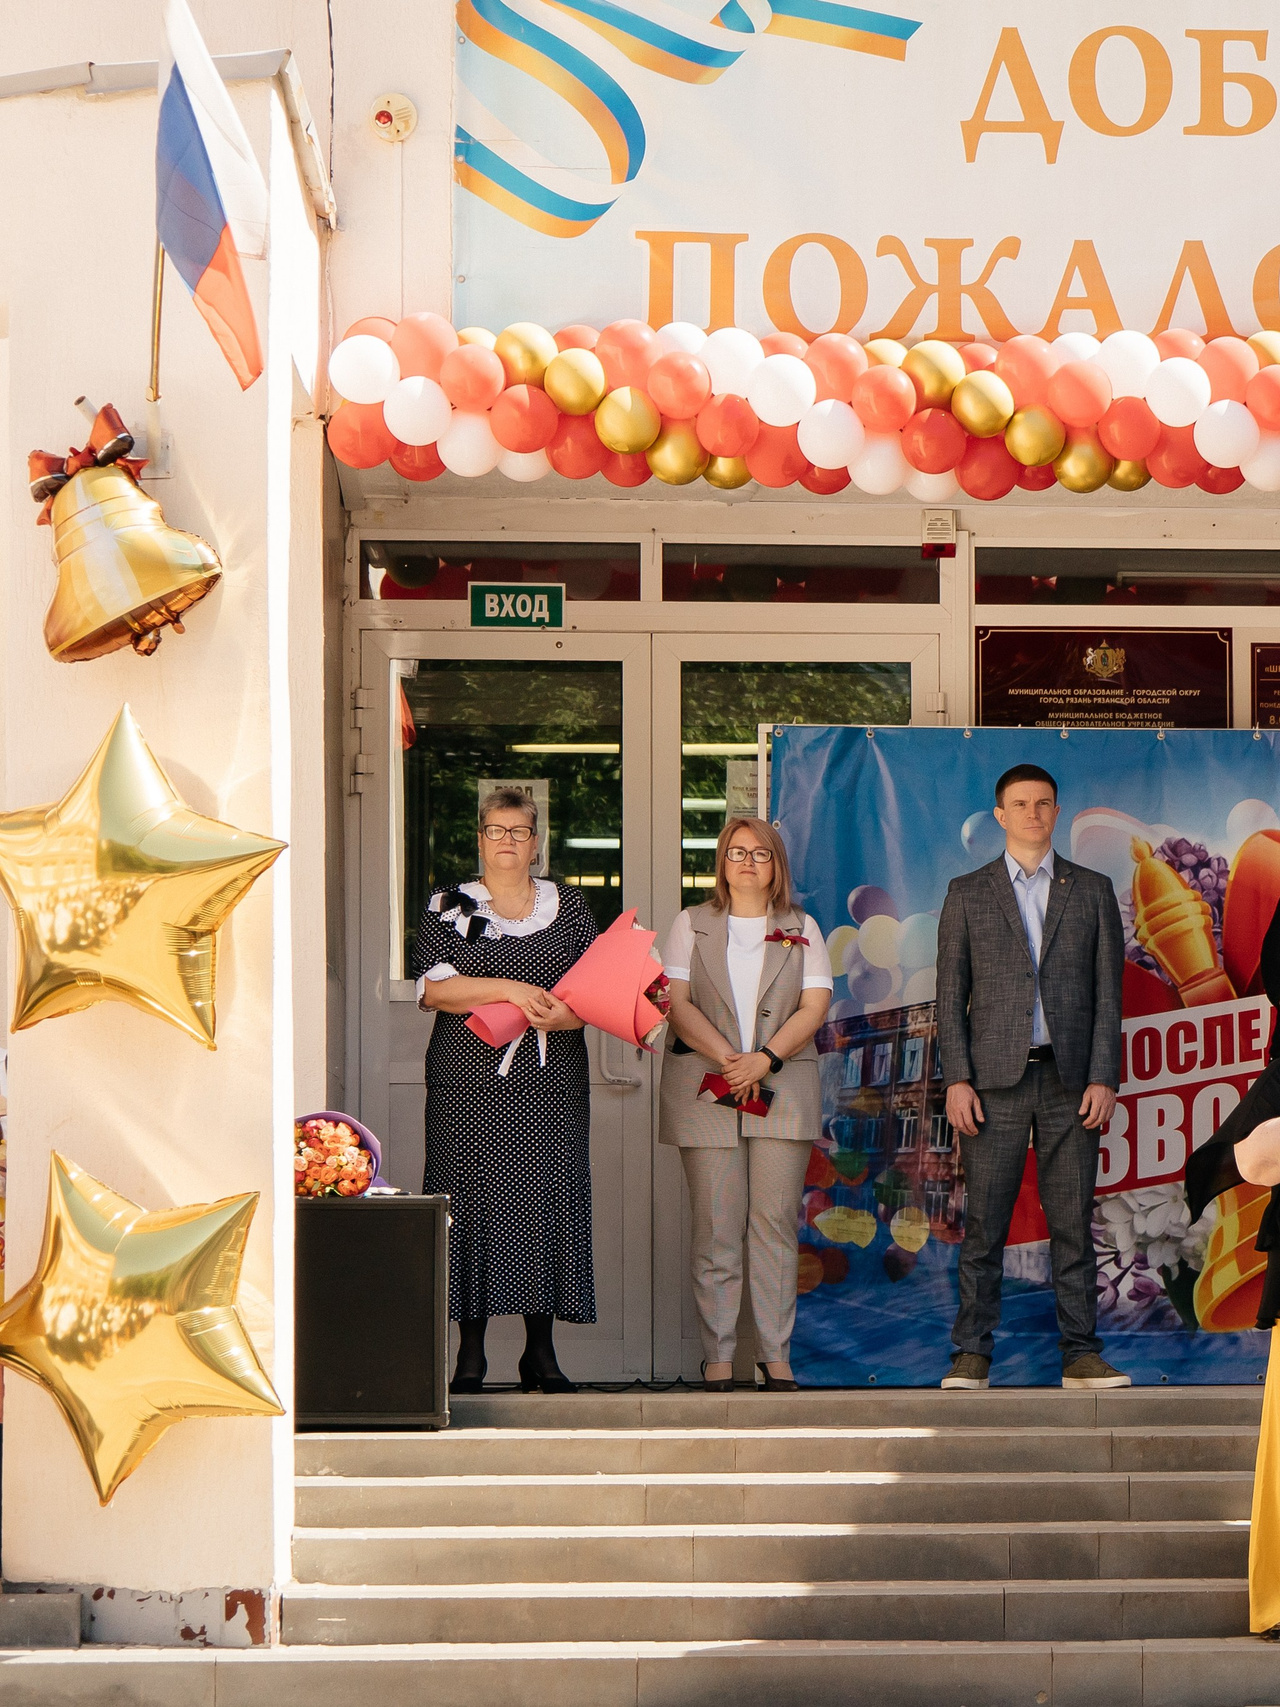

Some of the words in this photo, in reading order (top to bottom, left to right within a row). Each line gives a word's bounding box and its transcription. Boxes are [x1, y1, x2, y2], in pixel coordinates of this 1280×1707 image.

[485, 594, 549, 622] ВХОД
[1073, 688, 1124, 696] ОБРАЗОВАНИЕ
[1132, 688, 1177, 696] ГОРОДСКОЙ
[1121, 1006, 1277, 1083] ОСЛЕ
[1096, 1079, 1257, 1187] ЗВО
